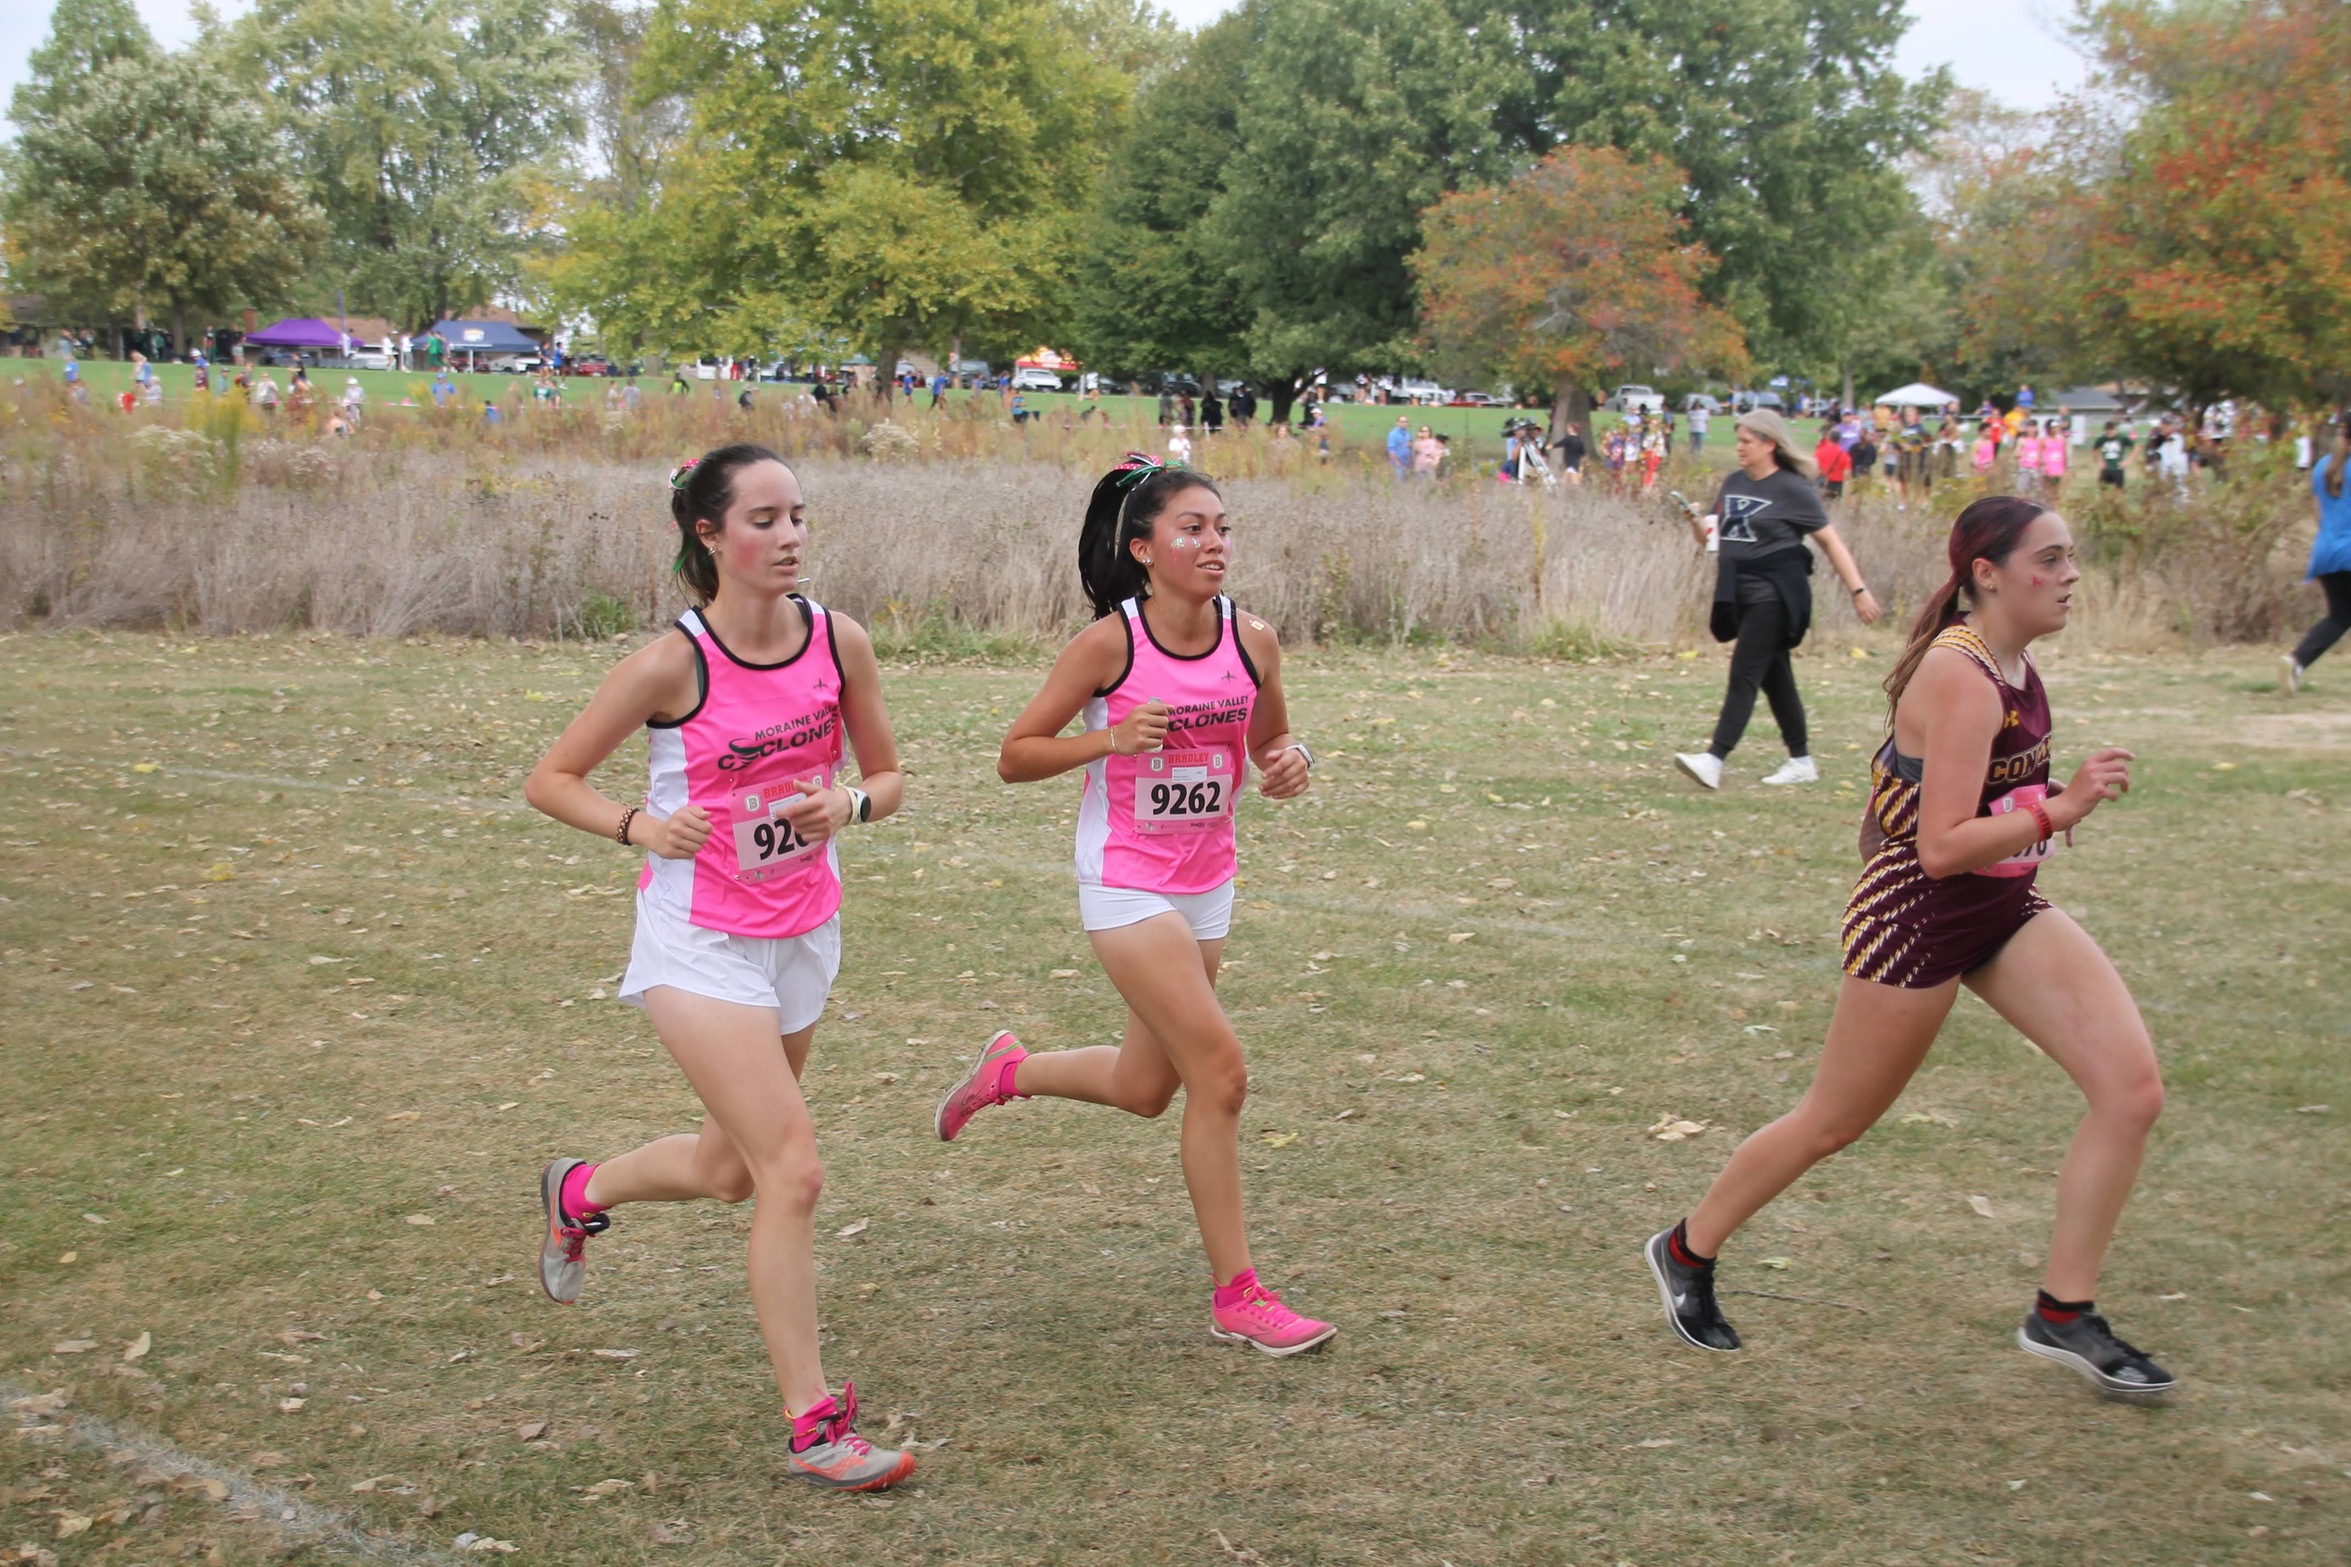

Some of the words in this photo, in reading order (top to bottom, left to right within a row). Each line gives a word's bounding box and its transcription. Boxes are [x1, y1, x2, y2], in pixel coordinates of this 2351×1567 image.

[1218, 695, 1249, 708] VALLEY
[755, 715, 811, 741] MORAINE
[813, 705, 839, 720] VALL
[1167, 707, 1248, 732] CLONES
[1168, 752, 1209, 763] BRADLEY
[1151, 781, 1221, 815] 9262
[754, 818, 809, 860] 92
